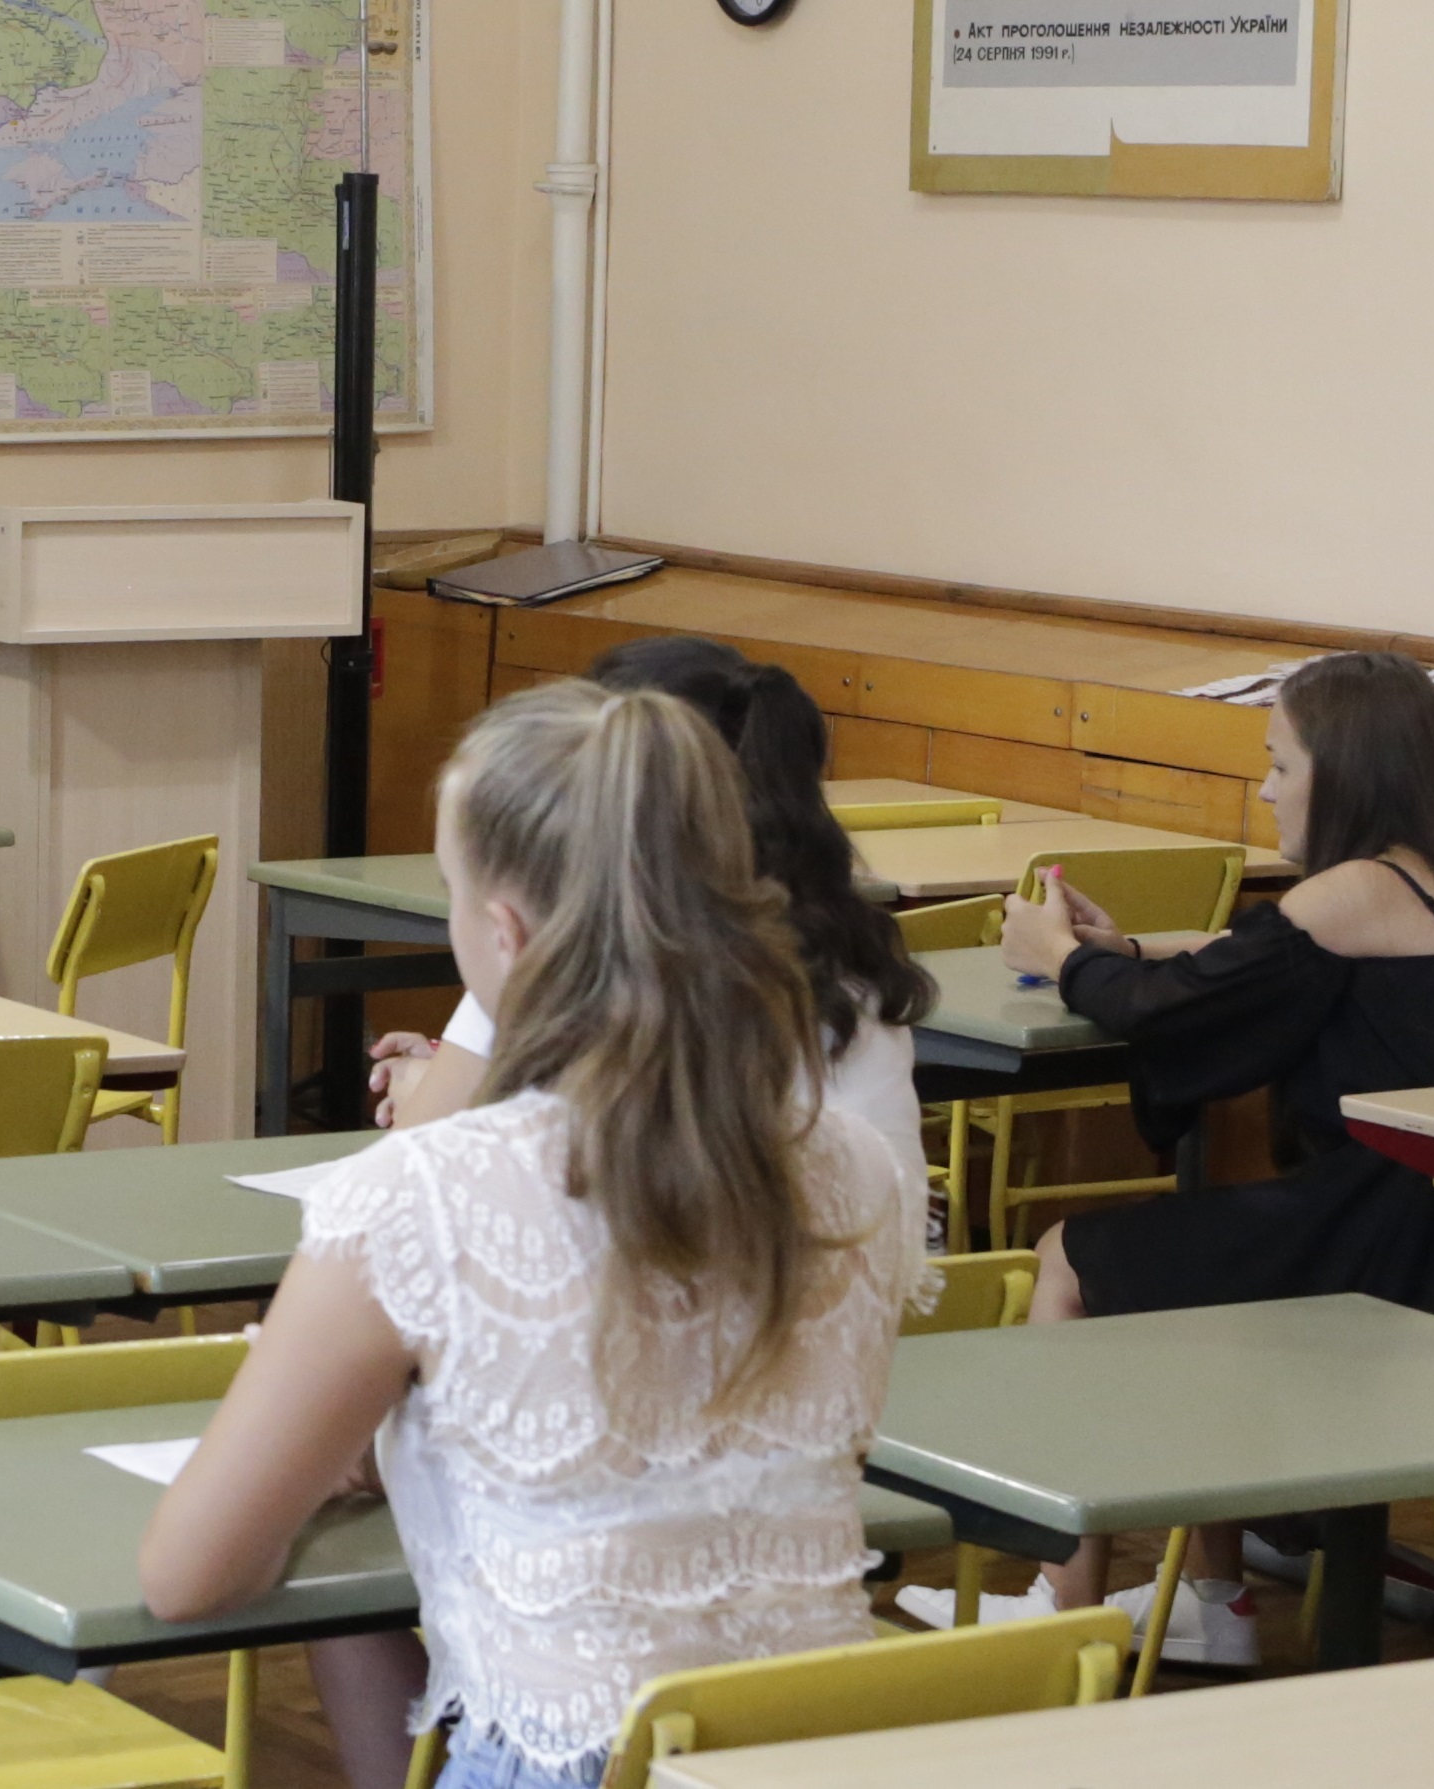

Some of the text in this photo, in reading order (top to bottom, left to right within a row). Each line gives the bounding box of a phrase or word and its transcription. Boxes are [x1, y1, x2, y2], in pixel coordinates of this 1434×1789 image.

[968, 14, 1288, 39] АКТ ПРОГОЛОШЕННЯ НЕЗАЛЕЖНОСТІ УКРАЇНИ
[976, 46, 1026, 62] СЕРПНЯ
[1030, 45, 1059, 60] 1991
